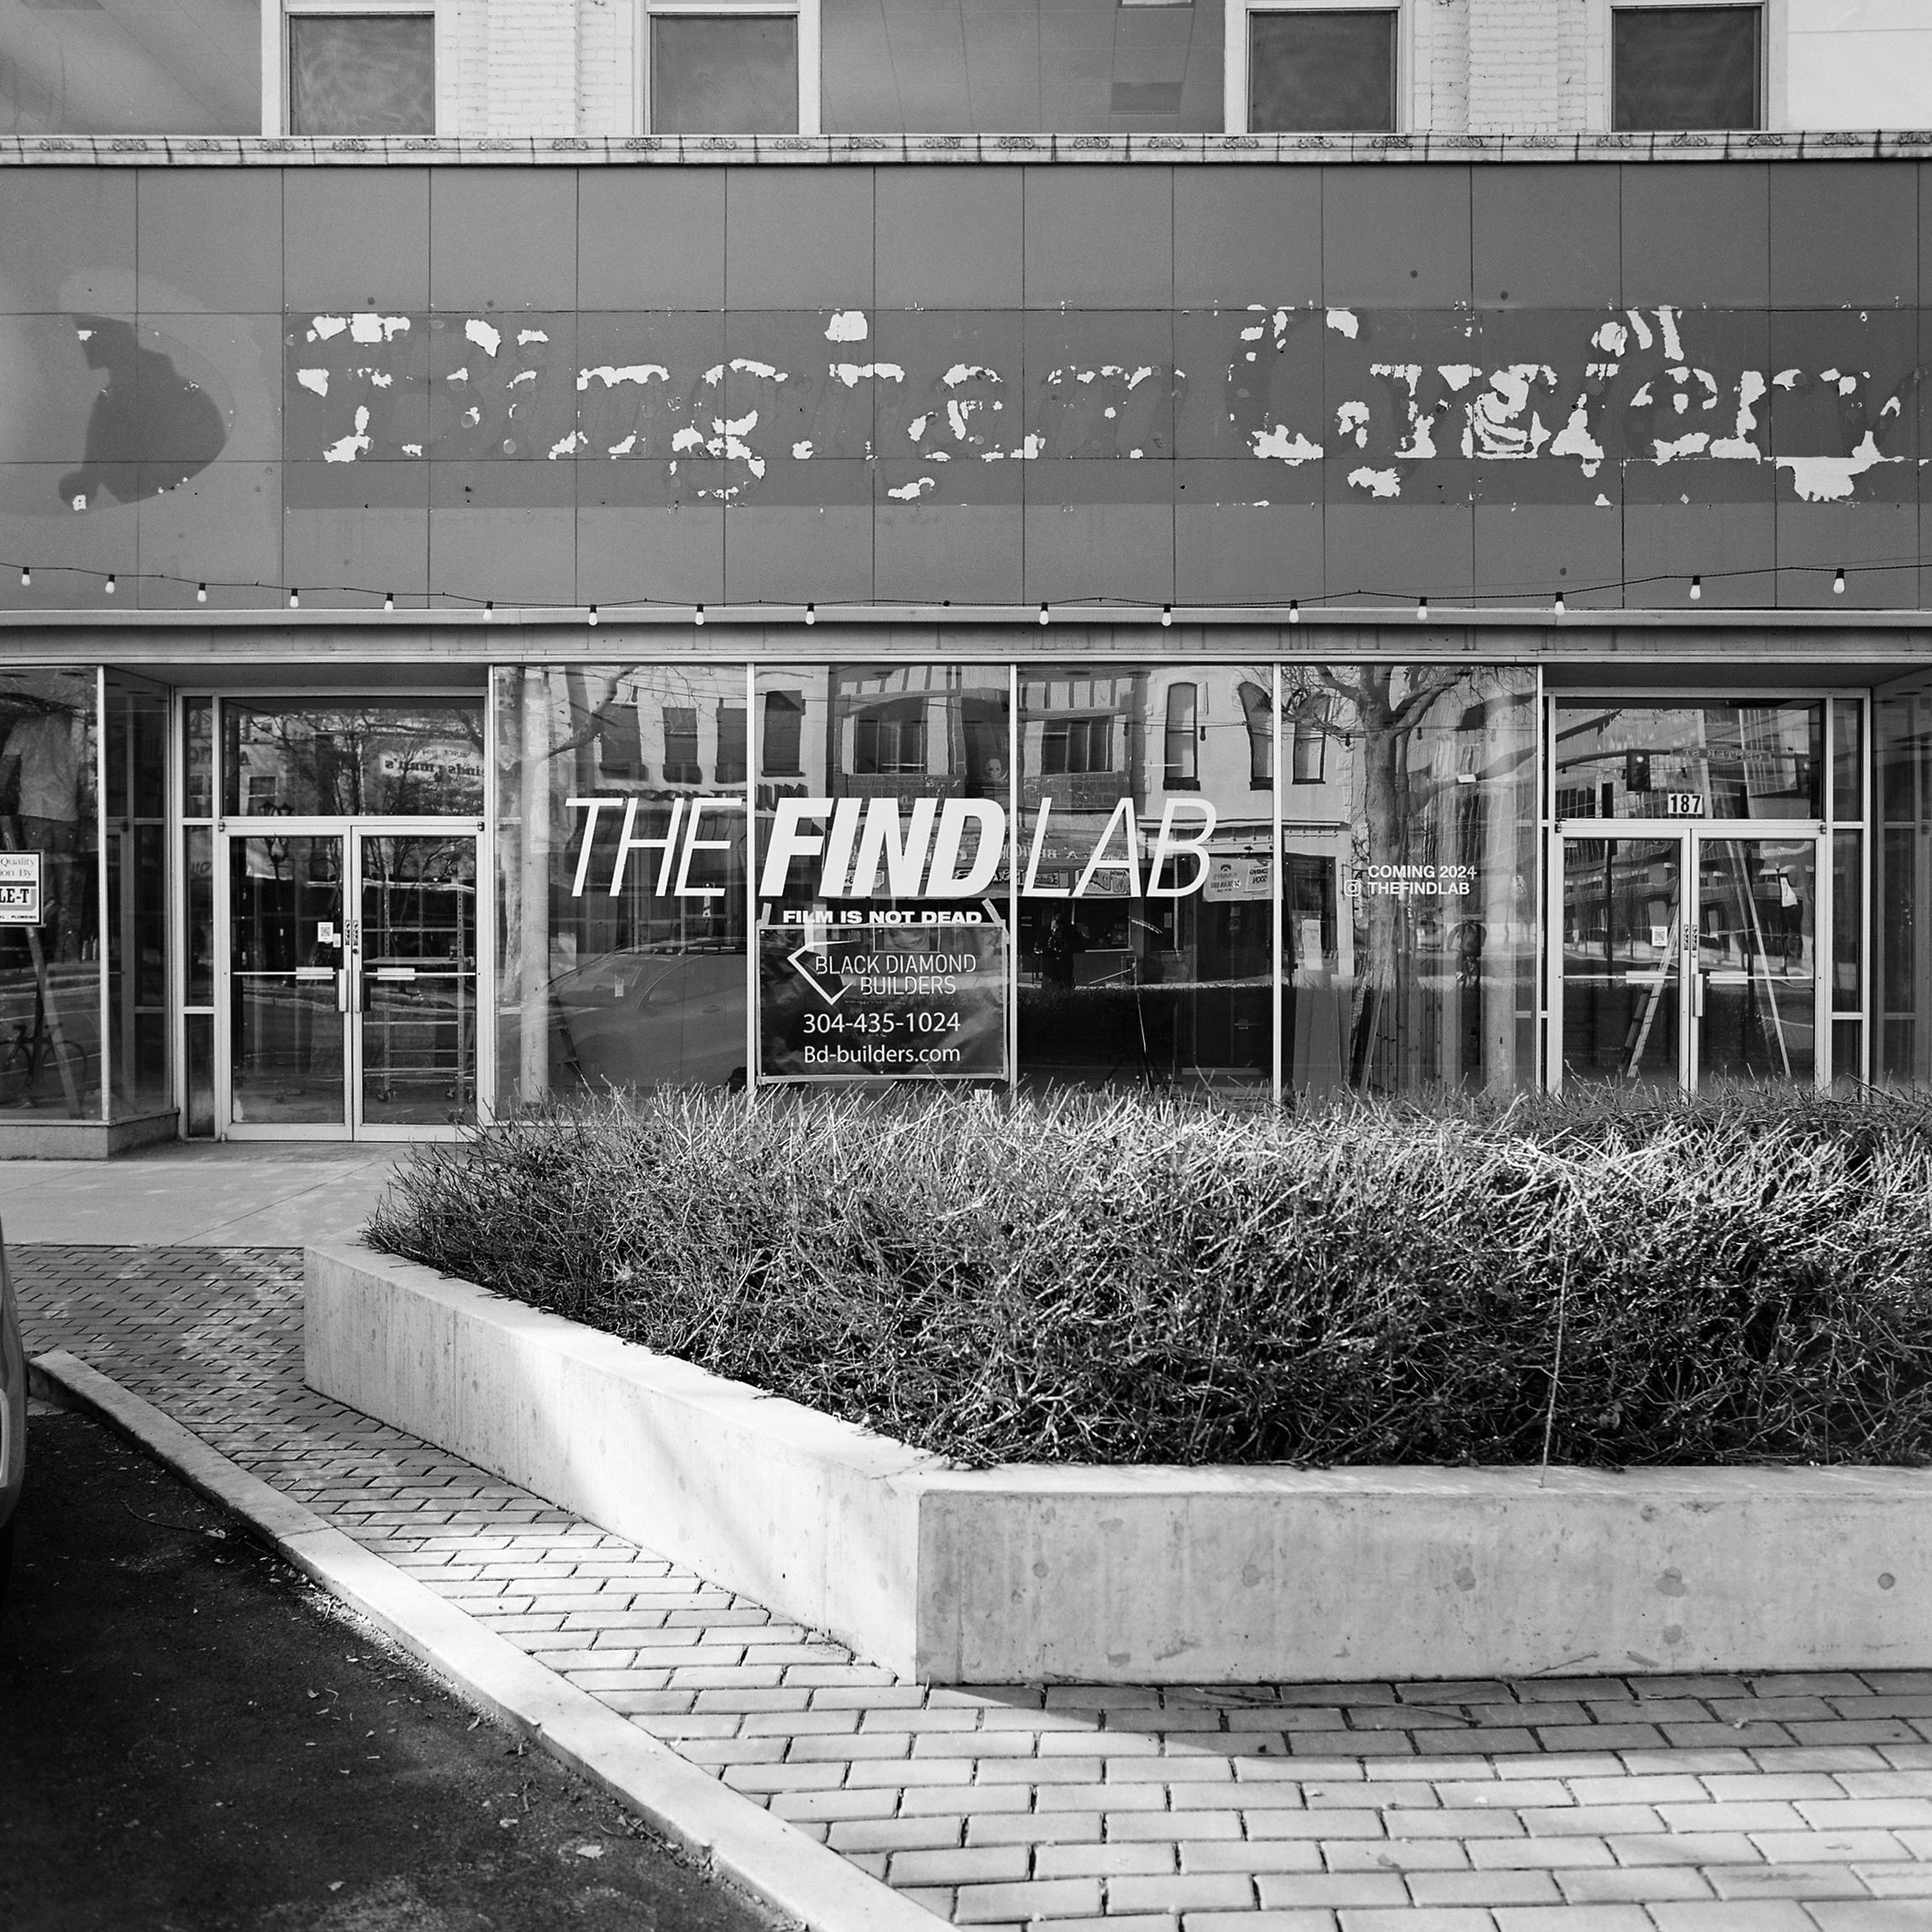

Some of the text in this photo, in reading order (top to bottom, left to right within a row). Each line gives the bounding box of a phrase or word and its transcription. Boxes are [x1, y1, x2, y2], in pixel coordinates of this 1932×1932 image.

[1670, 795, 1701, 814] 187
[565, 797, 1217, 897] THE FIND LAB
[1, 858, 35, 868] Quality
[1368, 865, 1477, 880] COMING 2024
[19, 869, 32, 878] By
[1369, 882, 1471, 895] THEFINDLAB
[783, 910, 982, 925] FILM IS NOT DEAD
[816, 954, 977, 976] BLACK DIAMOND
[860, 976, 956, 996] BUILDERS
[803, 1012, 961, 1034] 304-435-1024
[804, 1045, 961, 1064] Bd-builders.com
